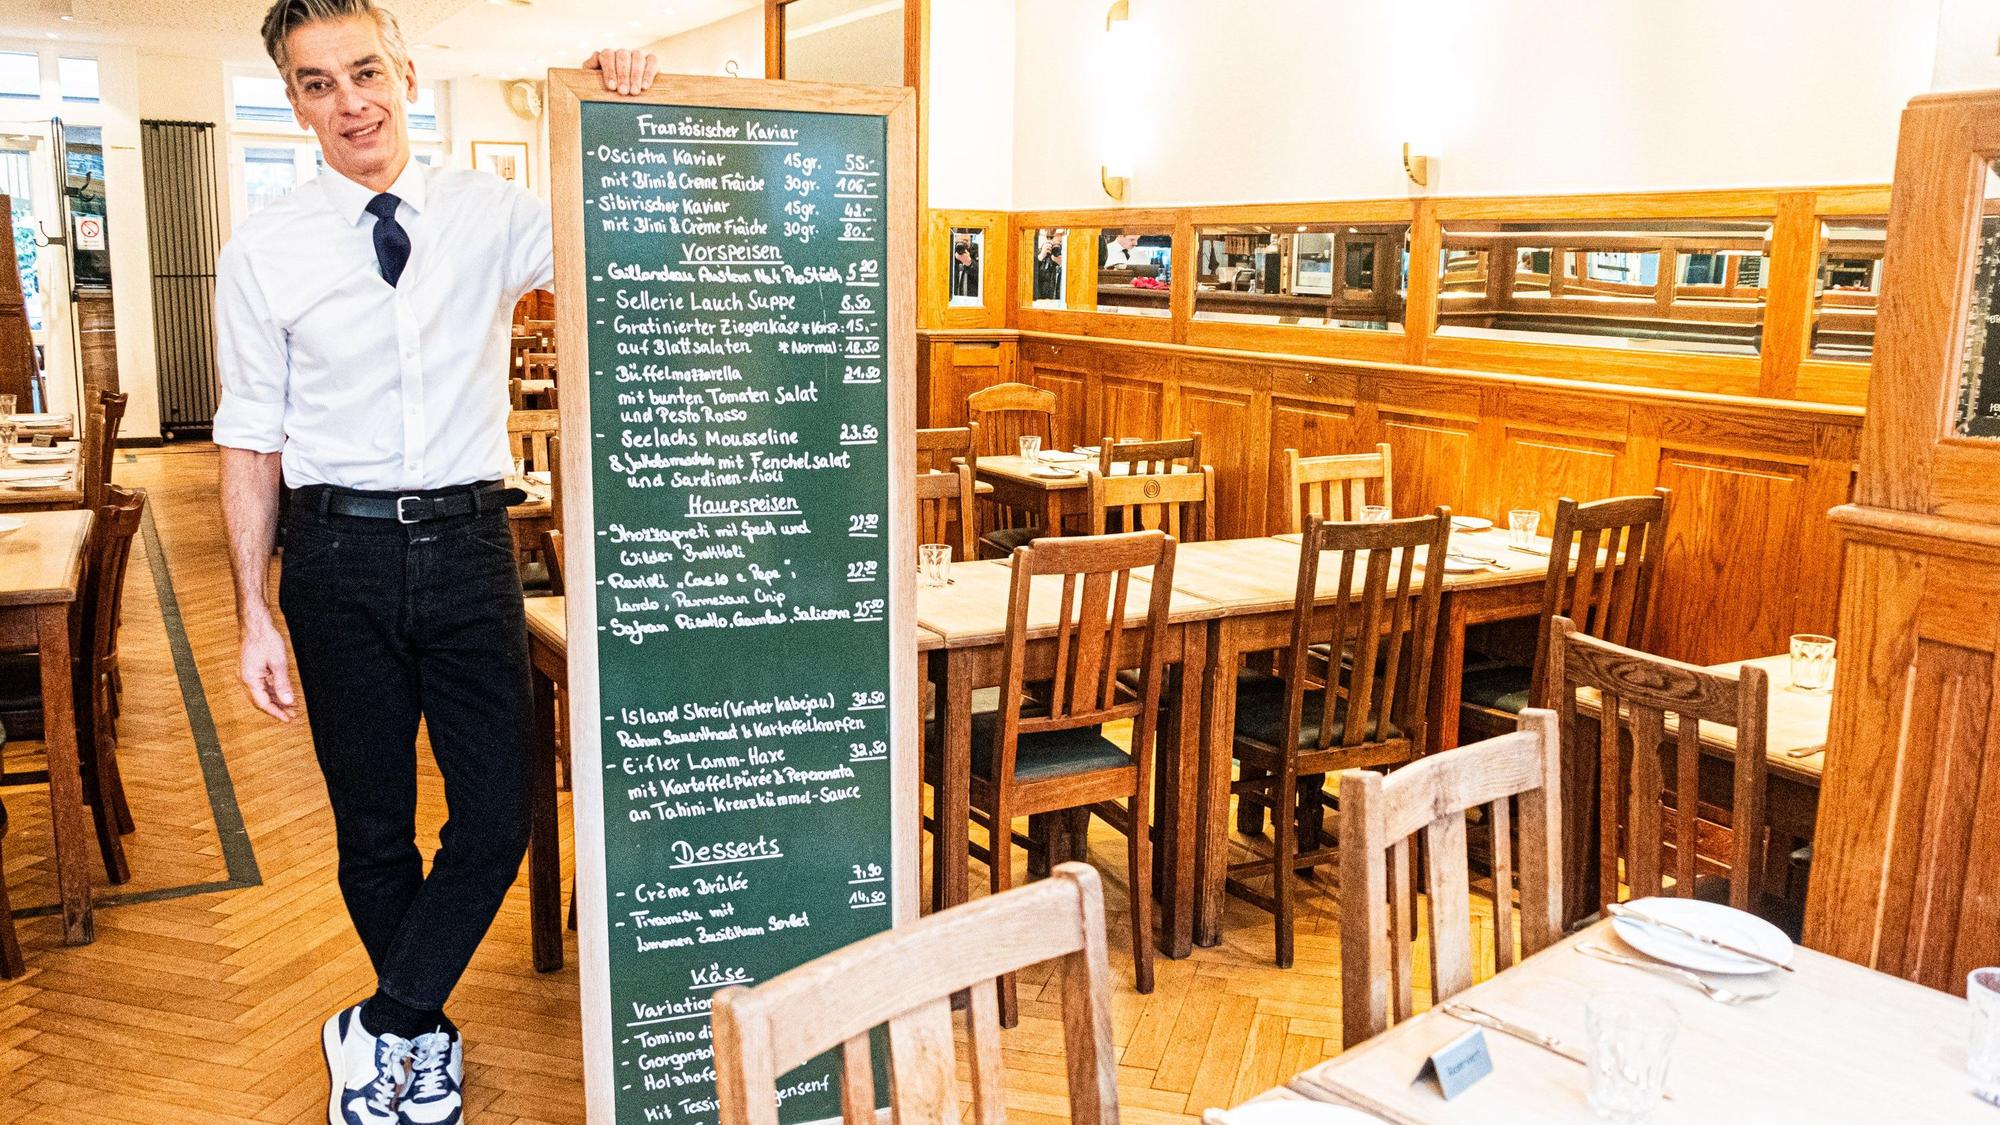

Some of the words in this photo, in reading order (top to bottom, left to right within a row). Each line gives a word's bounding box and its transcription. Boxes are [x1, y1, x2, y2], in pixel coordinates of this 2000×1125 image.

[636, 114, 740, 140] Französischer
[746, 121, 799, 140] Kaviar
[598, 145, 667, 165] Oscietra
[673, 148, 726, 166] Kaviar
[601, 171, 628, 188] mit
[632, 171, 667, 189] Blini
[666, 171, 678, 189] &
[599, 193, 680, 213] Sibirischer
[682, 198, 730, 214] Kaviar
[602, 216, 629, 231] mit
[634, 217, 667, 233] Blini
[669, 217, 681, 234] &
[681, 240, 783, 261] Vorspeisen
[616, 289, 684, 311] Sellerie
[690, 292, 743, 311] Lauch
[747, 289, 796, 311] Suppe
[613, 315, 716, 335] Gratinierter
[720, 314, 800, 337] Ziegenkäse
[617, 342, 649, 355] auf
[653, 338, 752, 355] Blattsalaten
[615, 364, 742, 382] Büffelmozzarella
[618, 388, 645, 406] mit
[649, 387, 704, 406] bunten
[705, 388, 769, 405] Tomaten
[774, 381, 818, 405] Salat
[620, 407, 653, 424] und
[656, 405, 700, 424] Pesto
[703, 405, 747, 422] Rosso
[620, 428, 698, 447] Seelachs
[705, 428, 799, 446] Mousseline
[609, 454, 626, 473] &
[718, 454, 745, 470] mit
[627, 473, 665, 489] und
[715, 523, 738, 537] mit
[781, 520, 811, 535] und
[620, 550, 673, 567] Wilder
[608, 572, 669, 589] Ravioli
[671, 591, 750, 608] Parmesan
[621, 705, 679, 725] Island
[616, 730, 662, 748] Rahm
[753, 716, 866, 739] Kartoffelkrapfen
[622, 754, 681, 775] Eifler
[628, 782, 656, 801] mit
[660, 769, 772, 797] Kartoffelpürée
[773, 769, 785, 785] &
[783, 764, 854, 784] Peperonata
[629, 808, 650, 822] an
[671, 835, 780, 865] Desserts
[635, 882, 690, 903] Crème
[693, 871, 749, 895] Brûlée
[629, 909, 703, 929] Tiramisu
[709, 902, 734, 918] mit
[768, 911, 810, 931] Sorbet
[690, 962, 748, 985] Käse
[634, 1027, 694, 1049] Tomino
[698, 1025, 713, 1041] di
[638, 1044, 715, 1070] Gorgonzol
[643, 1066, 718, 1091] Holzhofe
[643, 1104, 672, 1122] Mit
